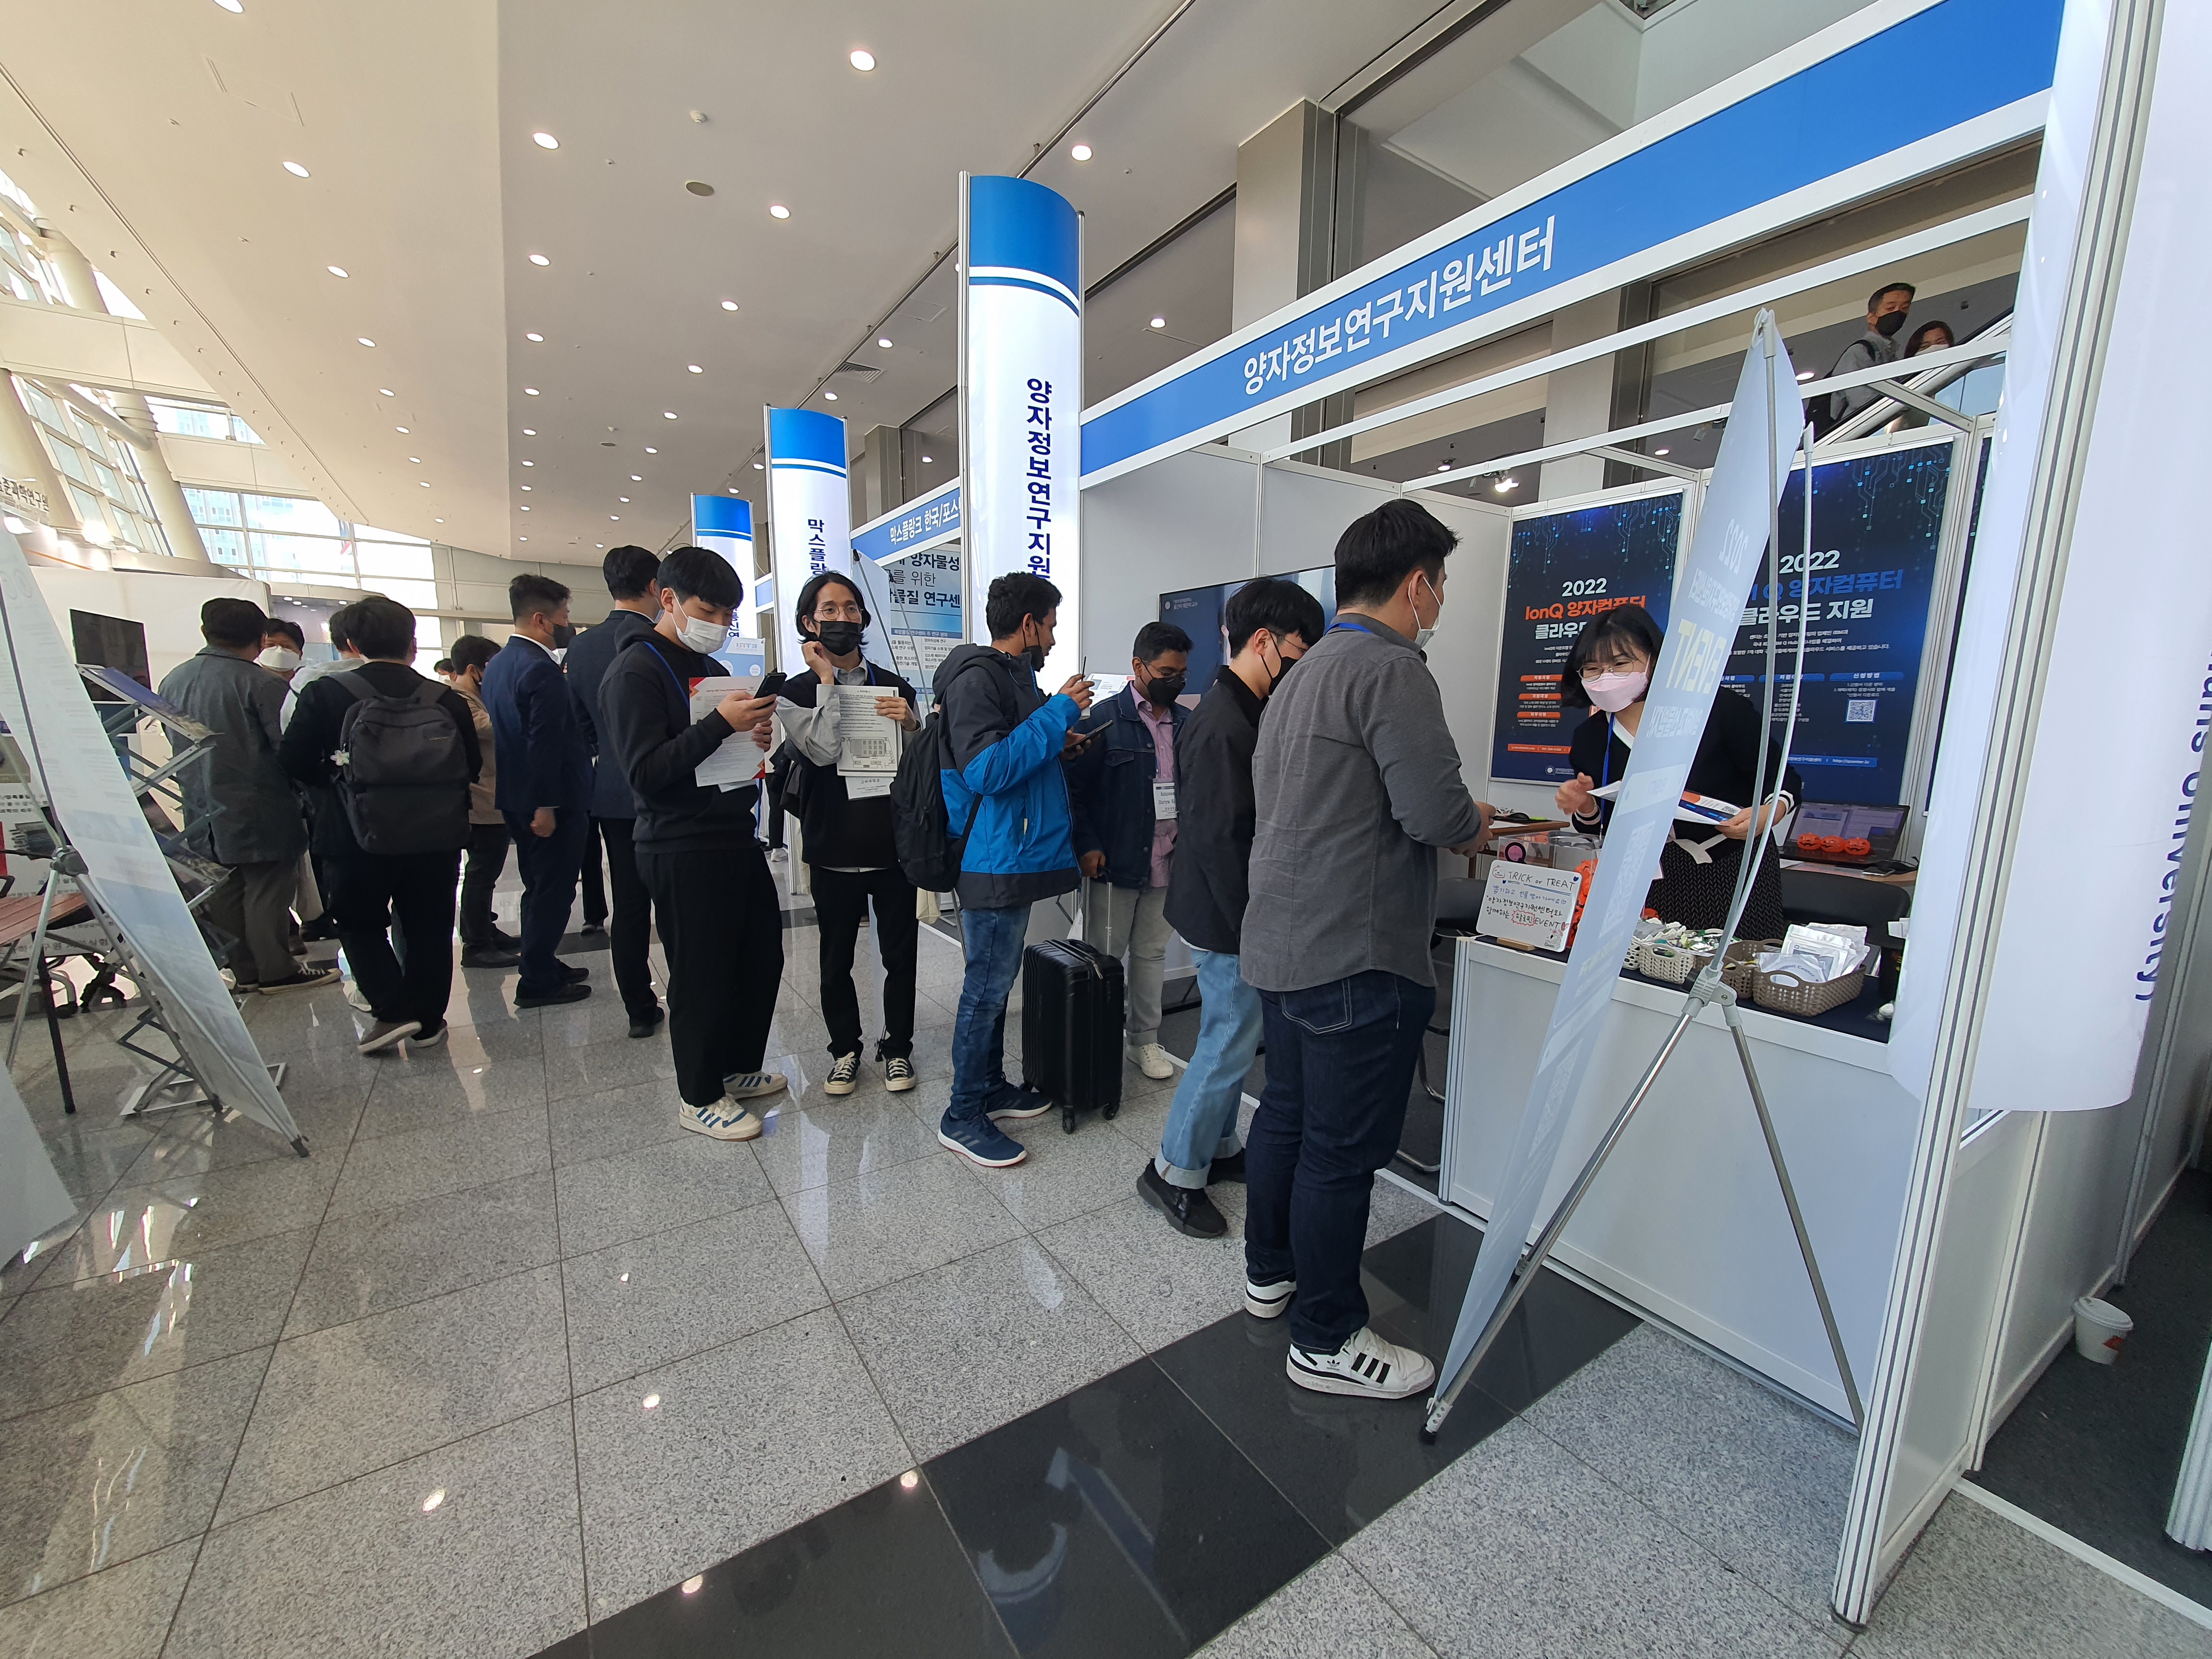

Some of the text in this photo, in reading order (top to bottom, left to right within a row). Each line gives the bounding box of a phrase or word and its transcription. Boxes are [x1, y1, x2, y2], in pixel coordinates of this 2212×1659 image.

[1244, 215, 1555, 396] 양자정보연구지원센터
[1026, 378, 1052, 579] 양자정보연구지원
[890, 496, 960, 545] 막스플랑크 한국/포스
[808, 519, 827, 576] 막스플랑
[911, 552, 960, 571] 양자물성
[1779, 550, 1840, 574] 2022
[911, 571, 936, 587] 위한
[1562, 577, 1607, 597] 2022
[1789, 569, 1903, 598] 양자컴퓨터
[1525, 603, 1564, 620] IonQ
[1740, 599, 1874, 625] 클라우드 지원
[1508, 871, 1533, 883] TRICK
[1547, 878, 1575, 891] TREAT
[1535, 917, 1561, 929] EVENT
[1797, 965, 1815, 976] Center
